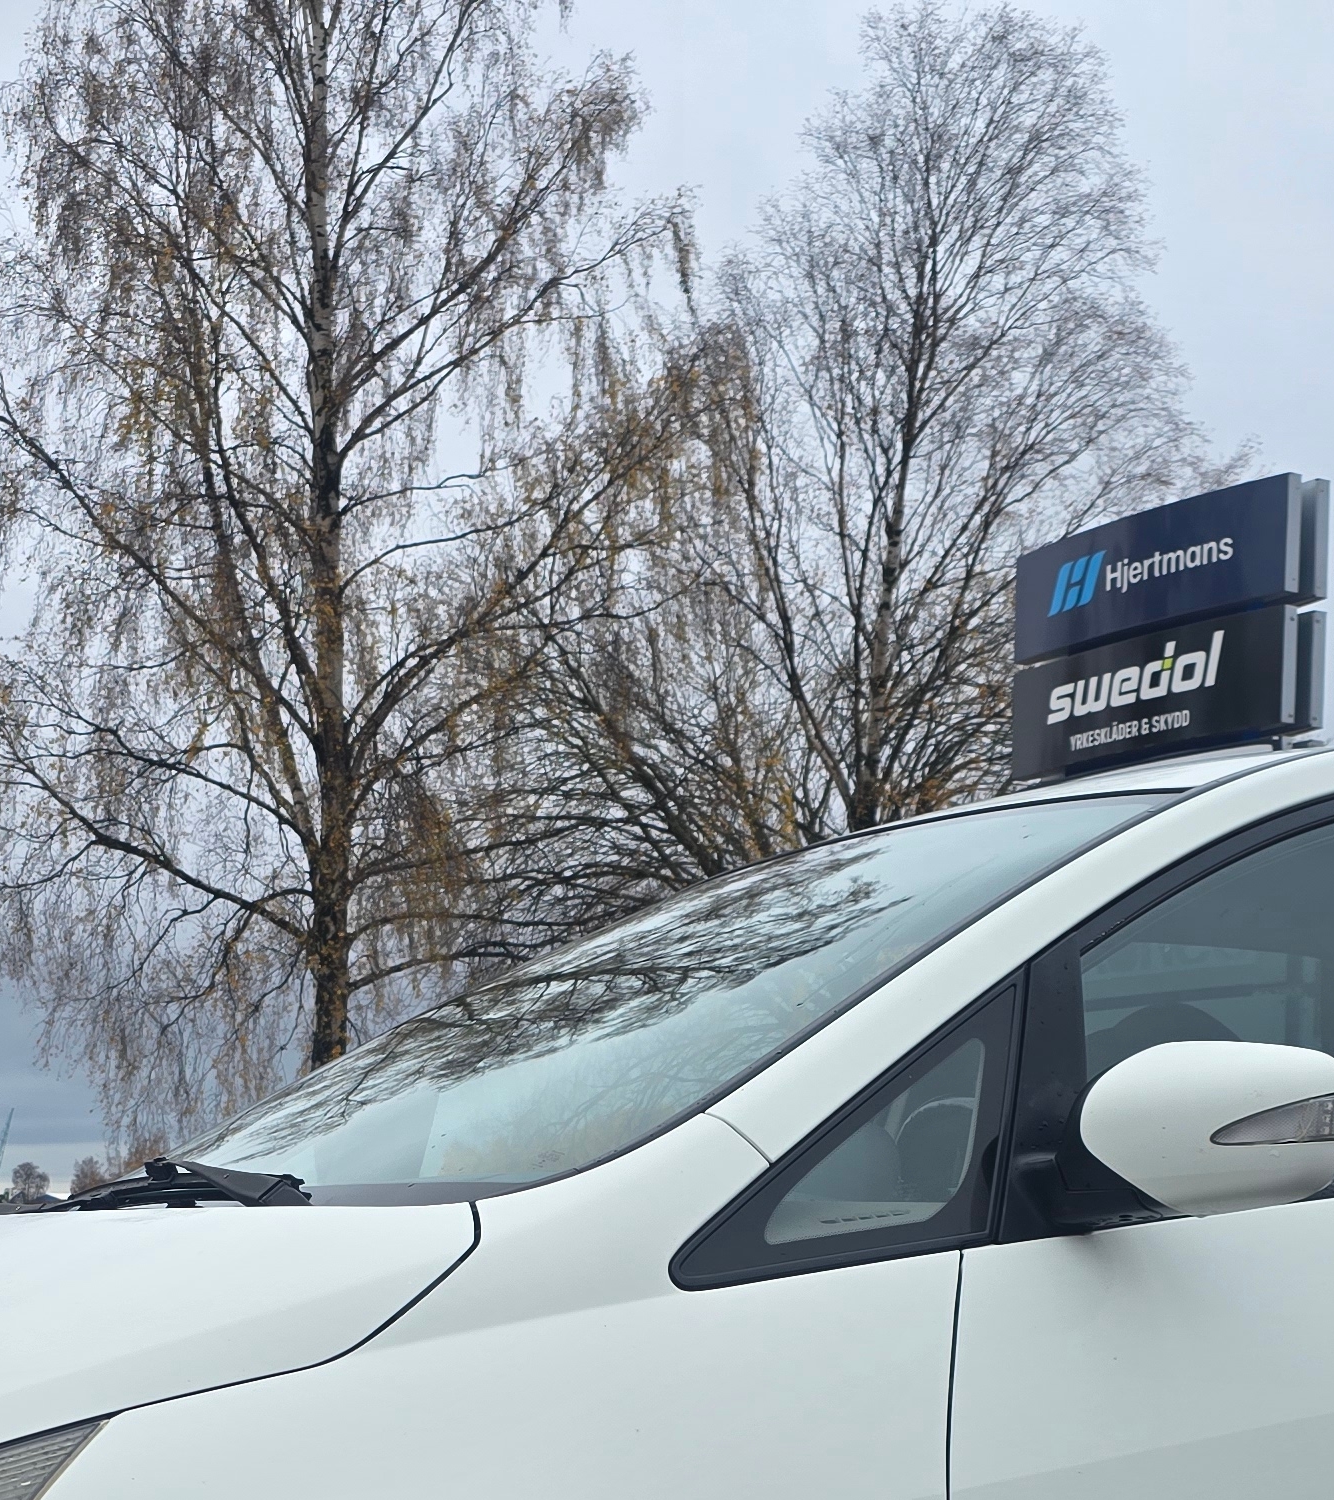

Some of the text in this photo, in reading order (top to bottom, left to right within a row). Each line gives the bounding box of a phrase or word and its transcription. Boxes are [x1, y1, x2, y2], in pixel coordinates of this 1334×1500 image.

[1105, 536, 1234, 594] Hjertmans
[1047, 629, 1225, 725] swedol
[1070, 709, 1191, 752] YRKESKLÄDER & SKYDD
